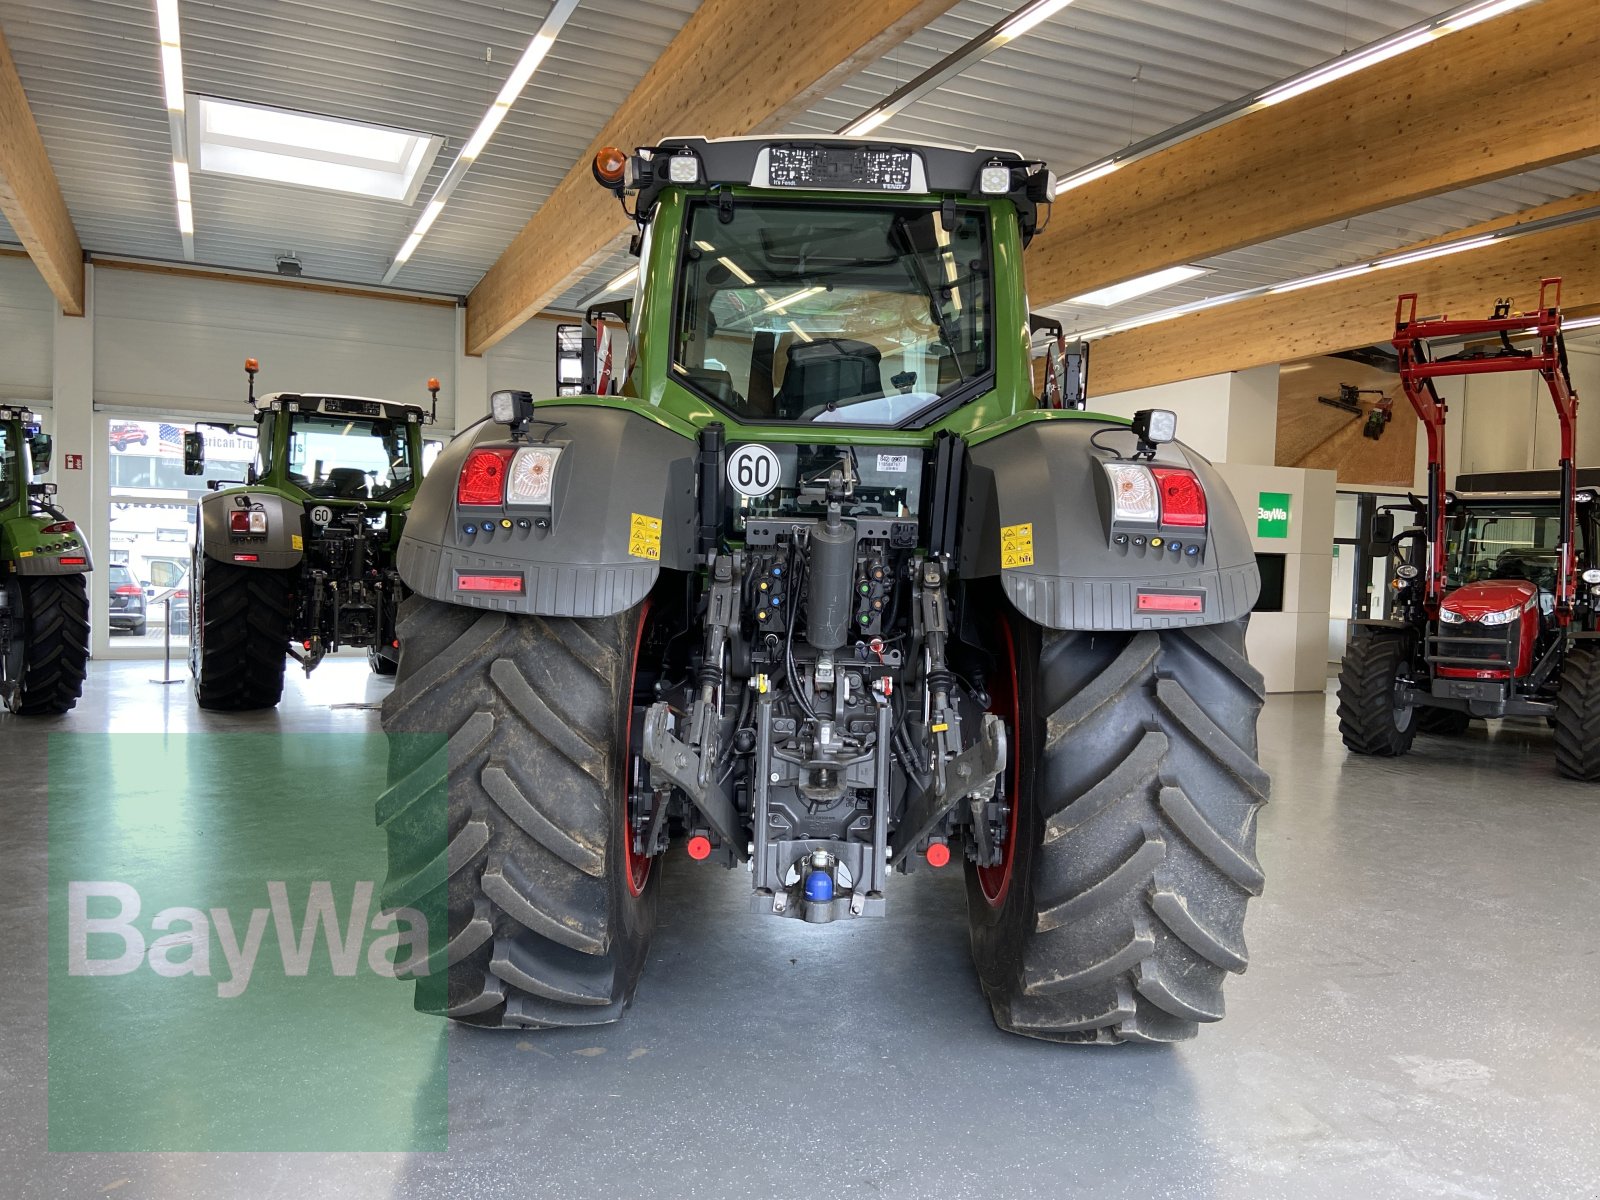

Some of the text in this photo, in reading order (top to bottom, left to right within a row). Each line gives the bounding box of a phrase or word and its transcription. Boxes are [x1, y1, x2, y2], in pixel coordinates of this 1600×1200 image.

[738, 454, 770, 487] 60
[314, 509, 328, 522] 60
[1257, 507, 1287, 522] BayWa
